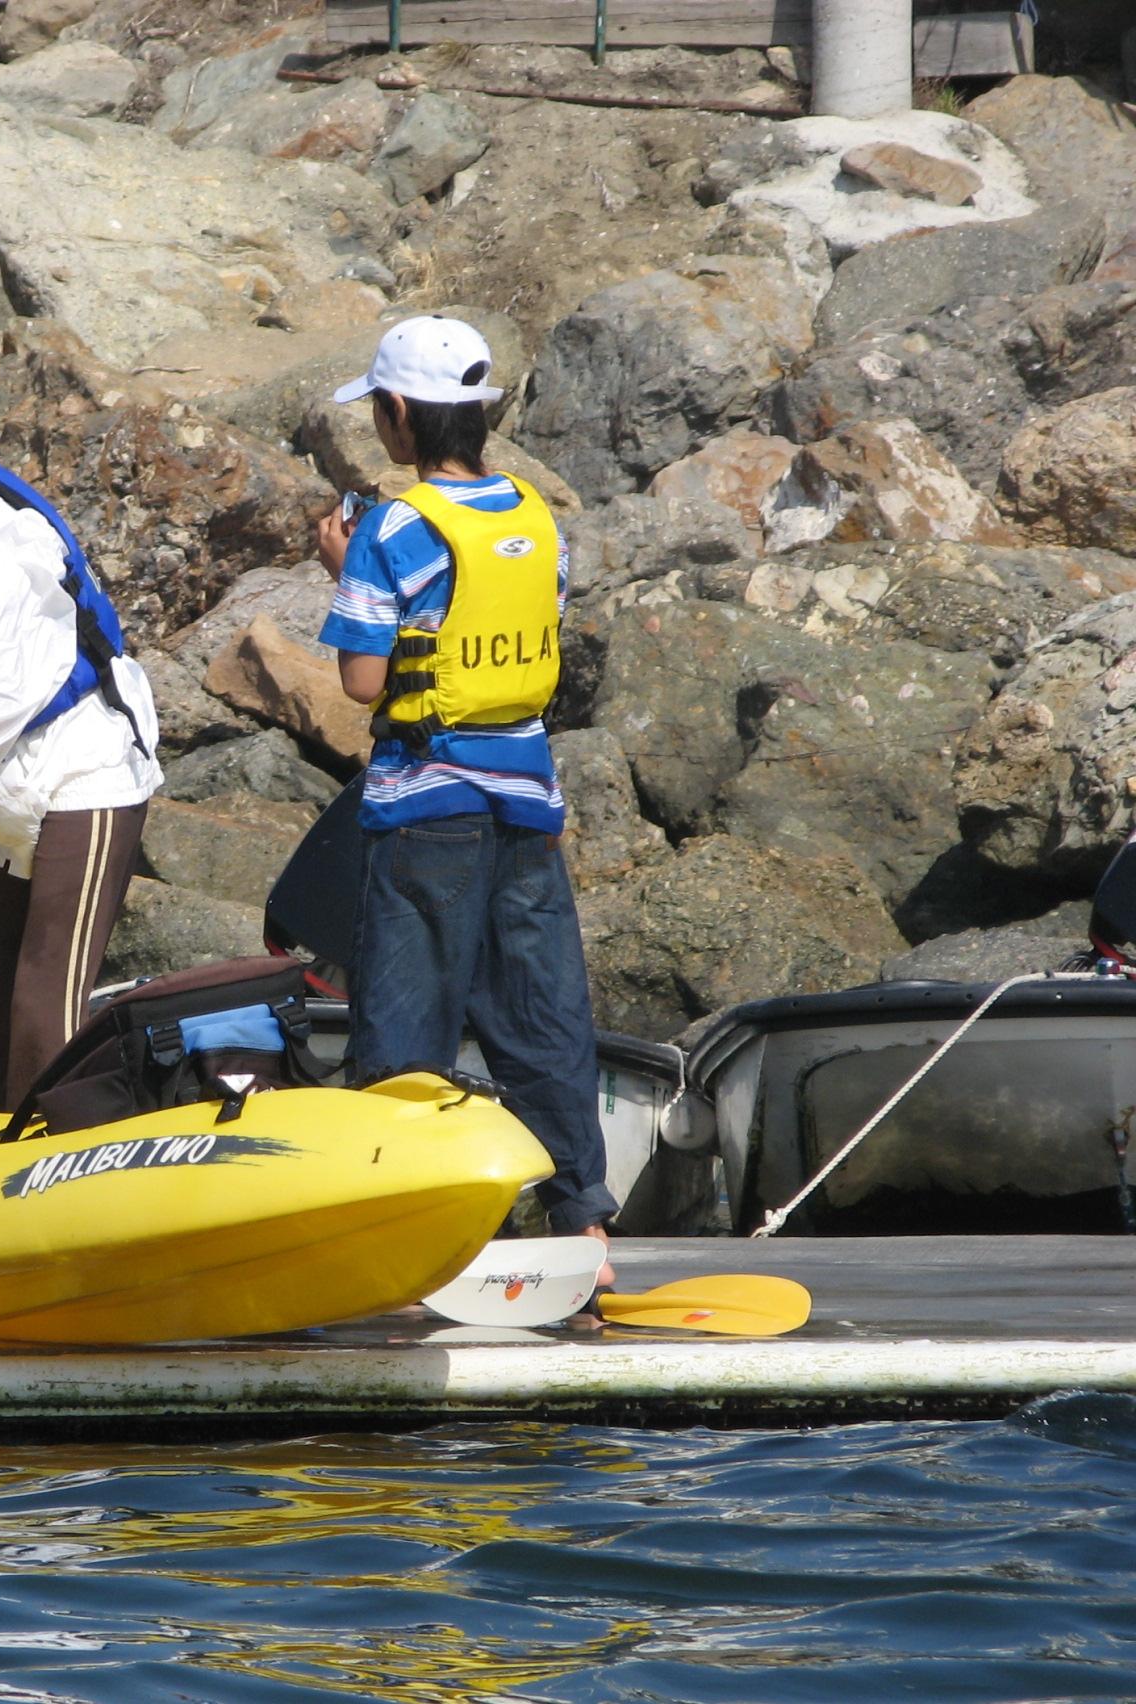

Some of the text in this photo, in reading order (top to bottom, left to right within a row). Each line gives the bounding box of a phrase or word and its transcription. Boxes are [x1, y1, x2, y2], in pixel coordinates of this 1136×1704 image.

[461, 625, 552, 669] UCLA
[20, 1134, 216, 1197] MALIBU TWO
